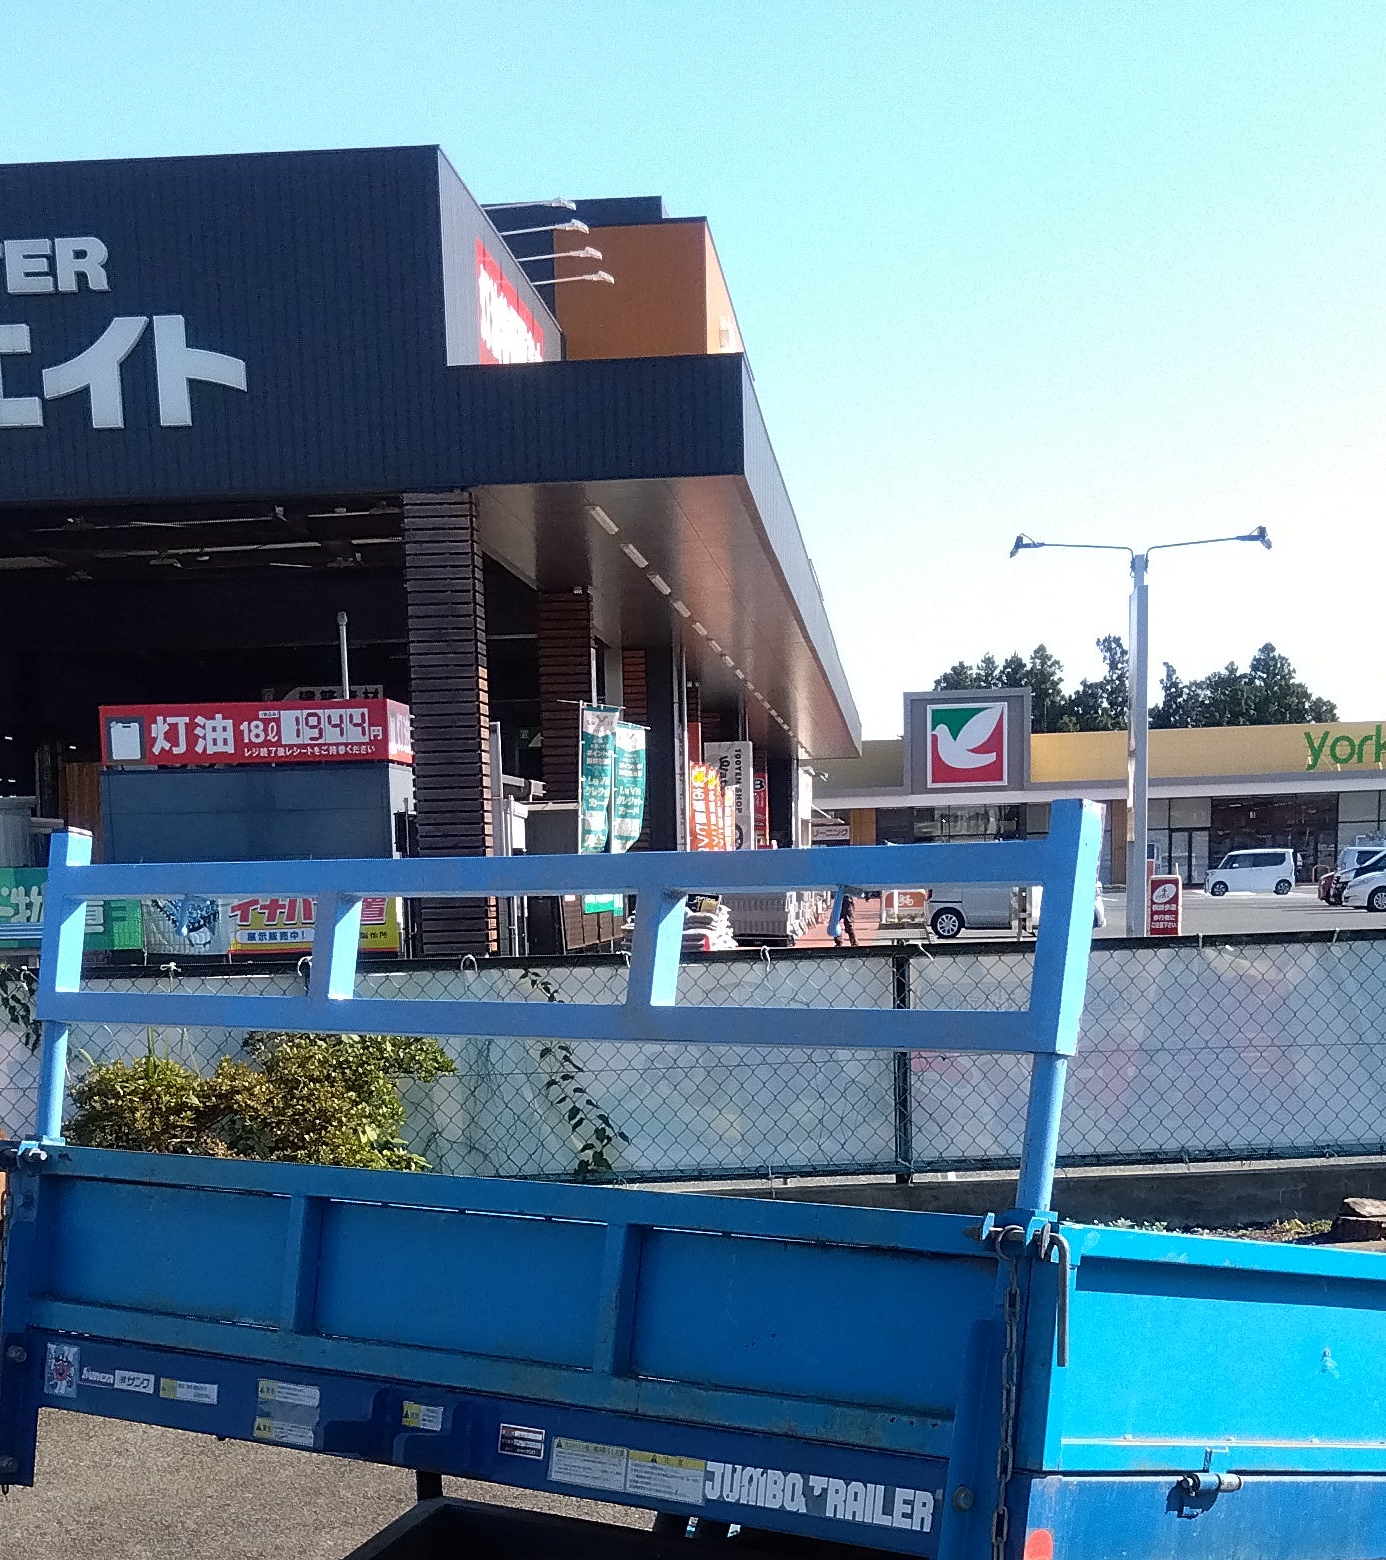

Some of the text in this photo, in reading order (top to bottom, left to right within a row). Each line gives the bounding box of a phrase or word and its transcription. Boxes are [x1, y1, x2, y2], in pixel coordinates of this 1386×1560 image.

[151, 713, 235, 755] 灯油
[705, 1461, 806, 1513] JUMBO
[810, 1475, 935, 1532] TRAILER
